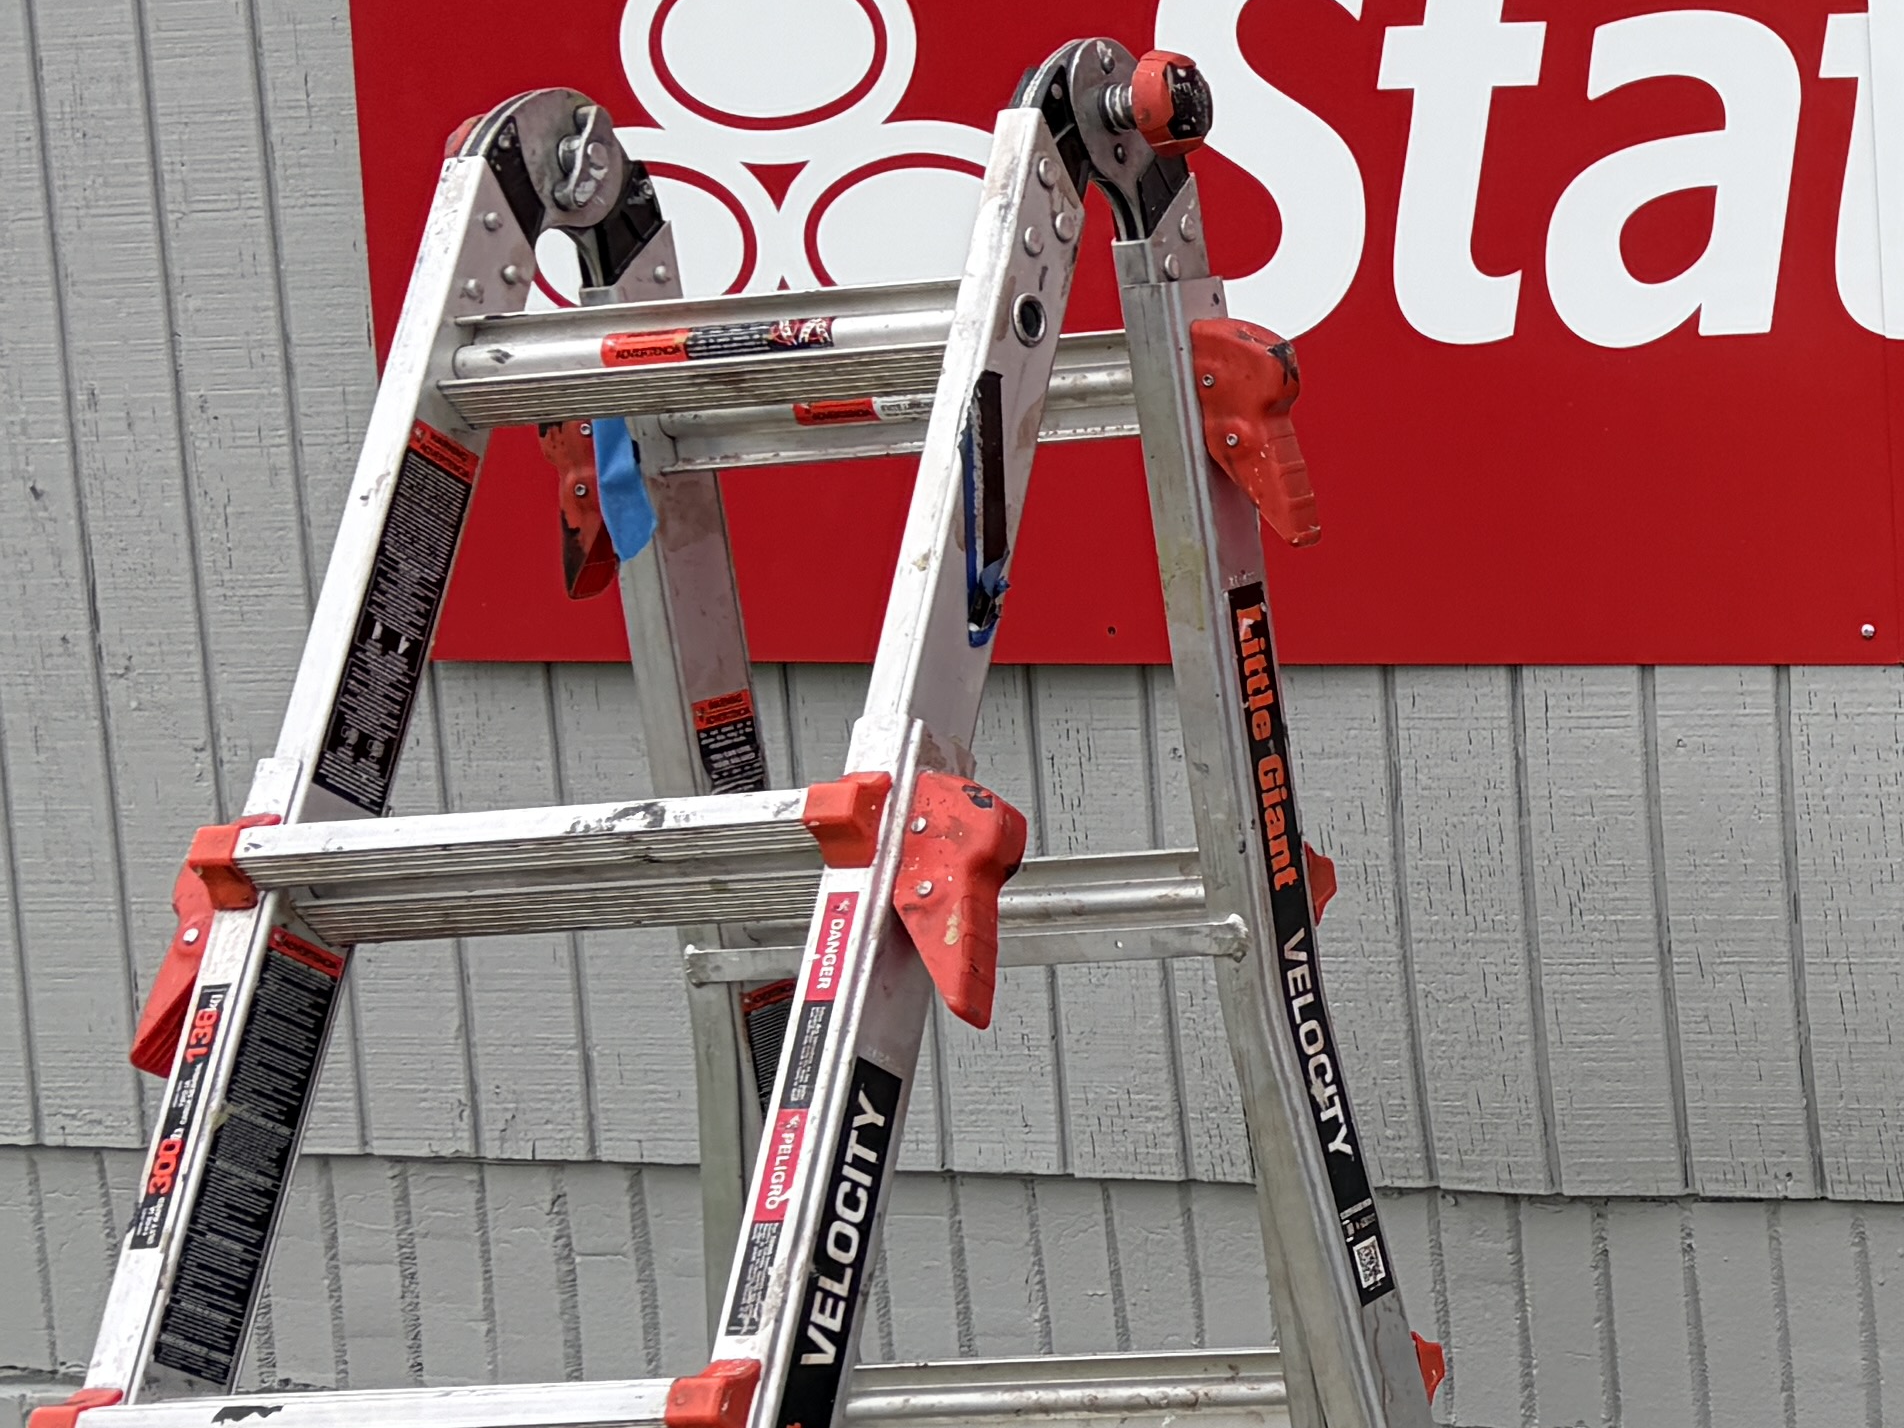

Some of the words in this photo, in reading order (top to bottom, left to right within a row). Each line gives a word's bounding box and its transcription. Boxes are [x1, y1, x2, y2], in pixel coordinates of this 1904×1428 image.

[815, 916, 845, 991] DANGER
[1235, 603, 1275, 742] Little
[1256, 750, 1300, 893] Giant
[1280, 927, 1355, 1157] VELOCITY
[763, 1131, 795, 1211] PELIGRO
[799, 1088, 887, 1368] VELOCITY
